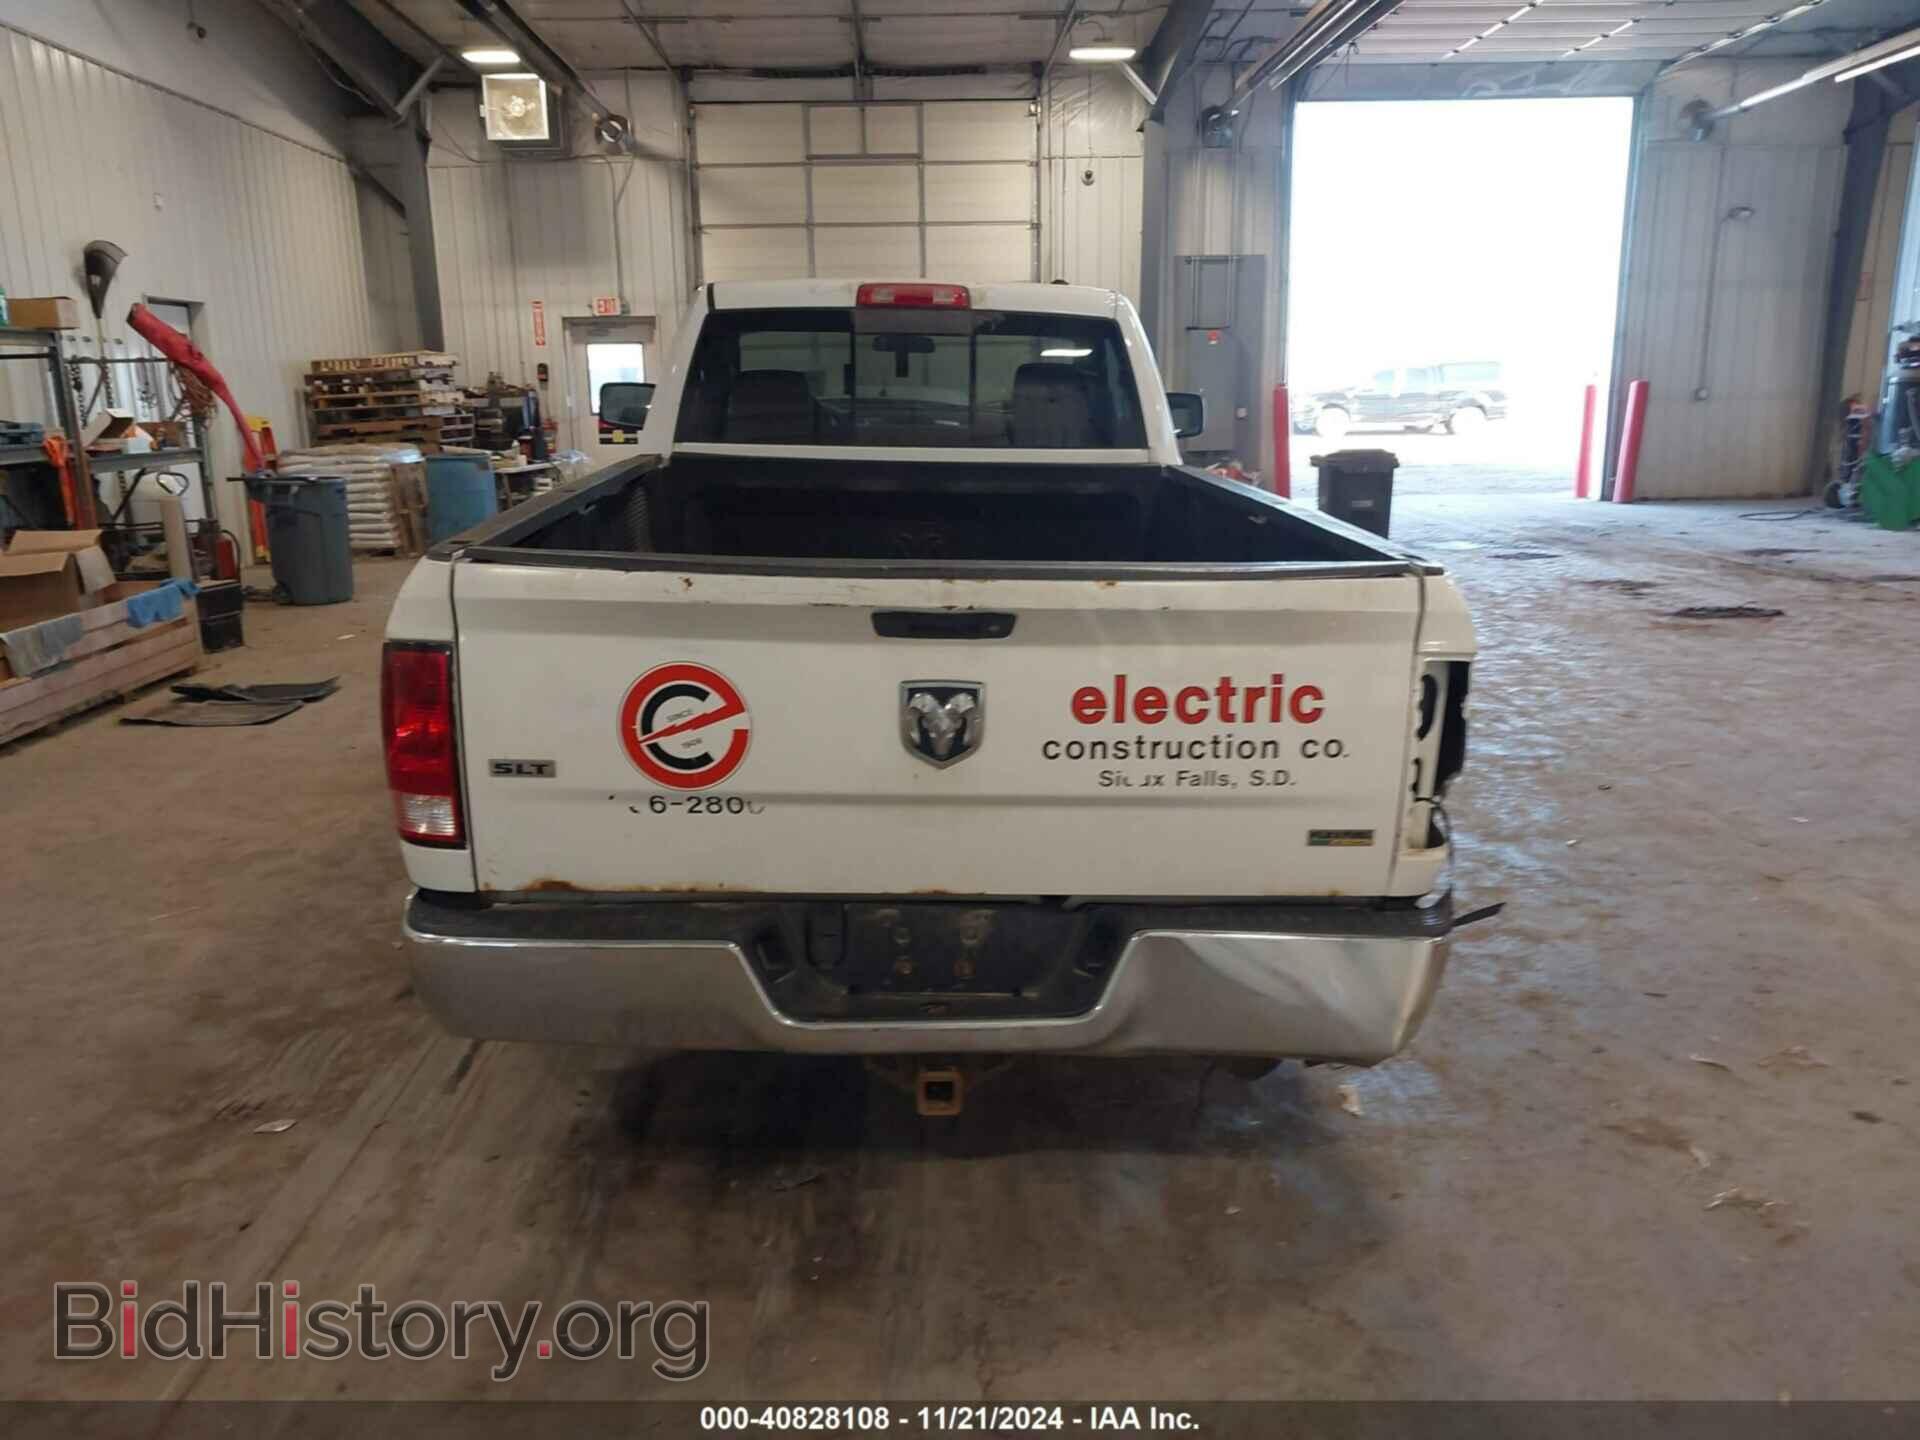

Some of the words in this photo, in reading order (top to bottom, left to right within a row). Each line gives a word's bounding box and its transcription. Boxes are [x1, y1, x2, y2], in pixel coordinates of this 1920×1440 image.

[1071, 673, 1325, 725] electric
[1042, 734, 1280, 760] construction
[1300, 737, 1351, 760] co.
[492, 762, 549, 775] SLT
[1176, 769, 1238, 789] Falls,
[1248, 769, 1298, 787] S.D.
